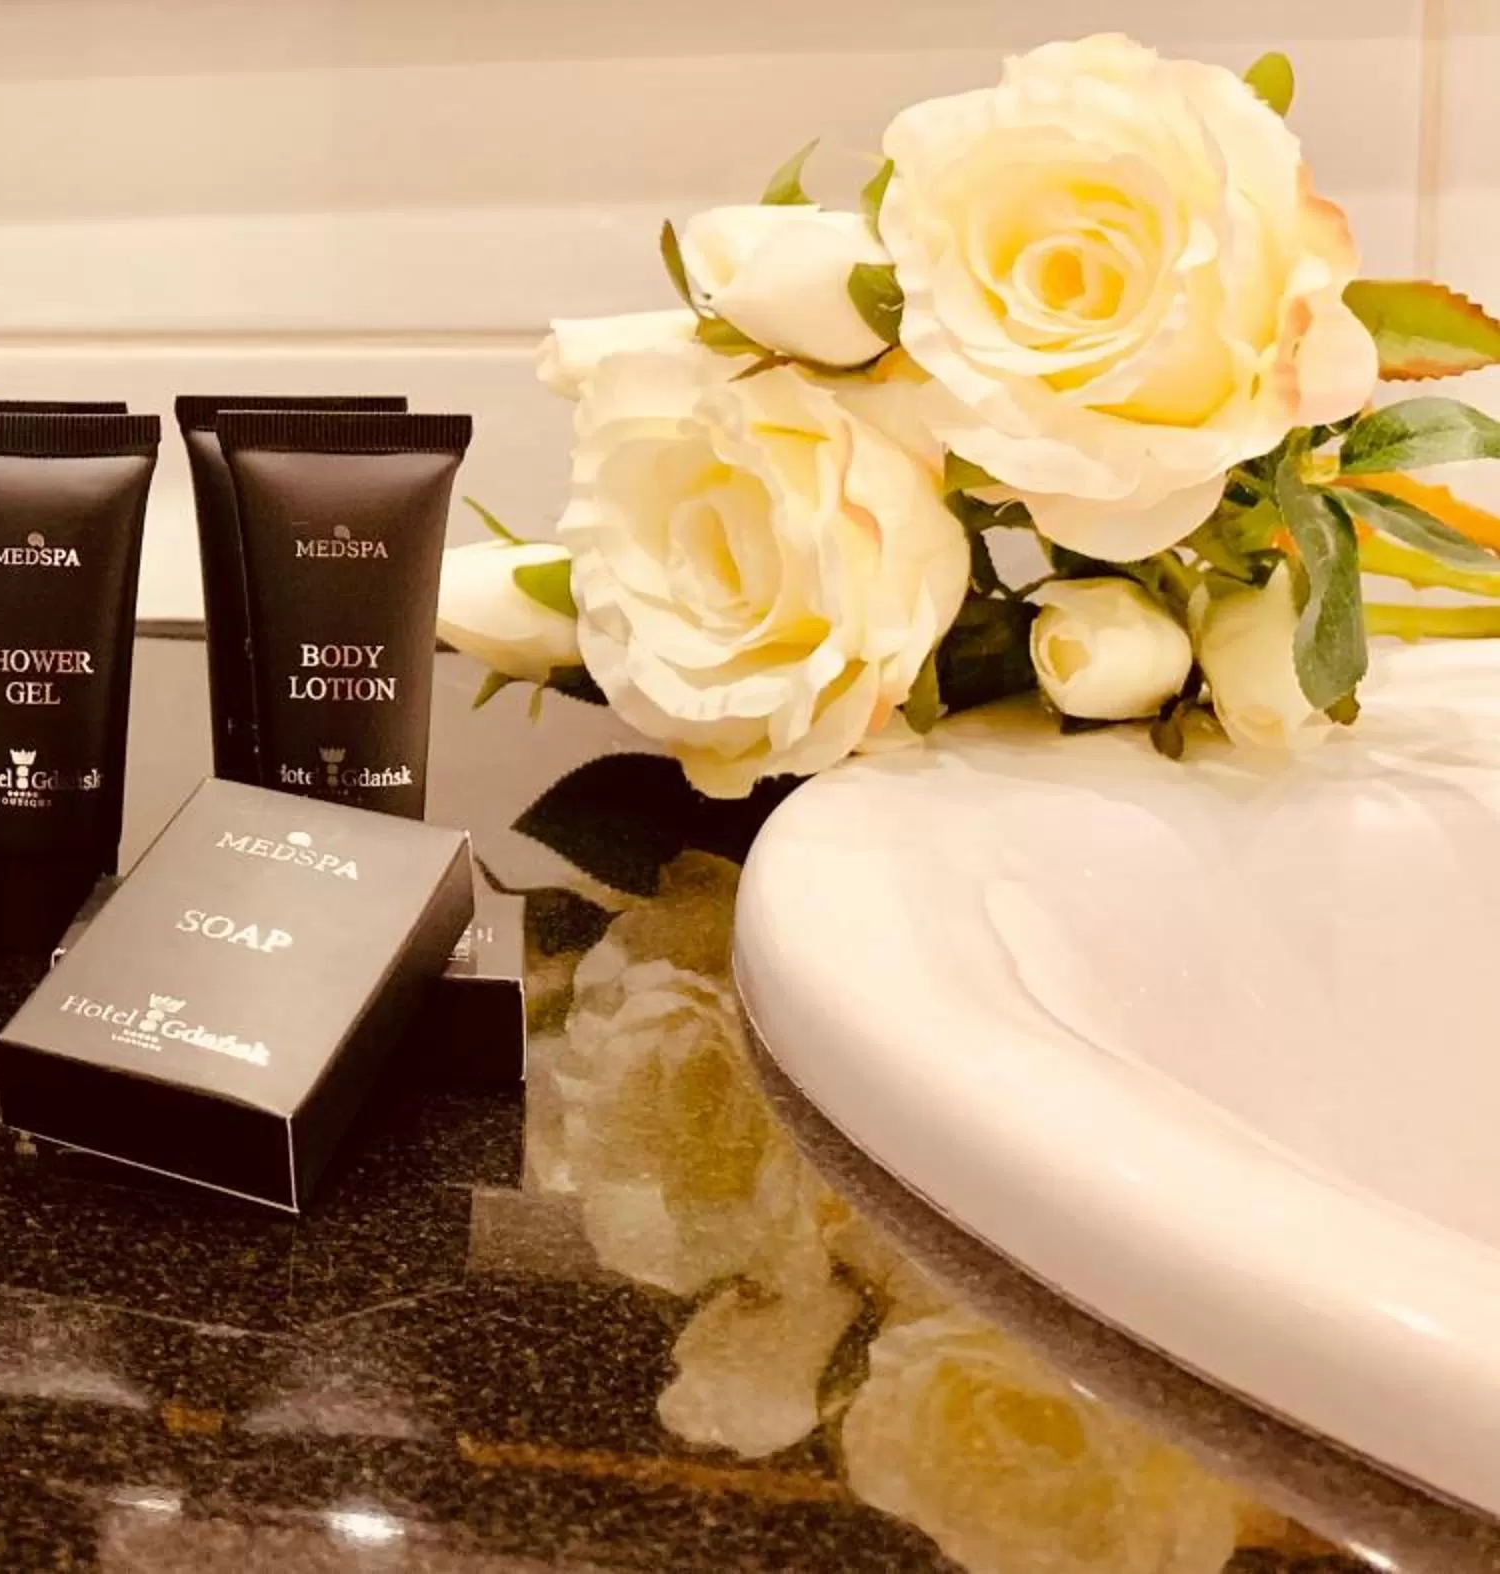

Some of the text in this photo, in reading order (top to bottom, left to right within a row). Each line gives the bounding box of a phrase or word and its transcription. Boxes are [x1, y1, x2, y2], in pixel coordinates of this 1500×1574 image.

[295, 540, 389, 559] MEDSPA
[300, 644, 384, 669] BODY
[5, 682, 61, 705] GEL
[288, 676, 397, 701] LOTION
[31, 767, 104, 791] Gdsk
[215, 831, 359, 881] MEDSPA
[175, 909, 293, 953] SOAP
[60, 995, 139, 1027] Hotel
